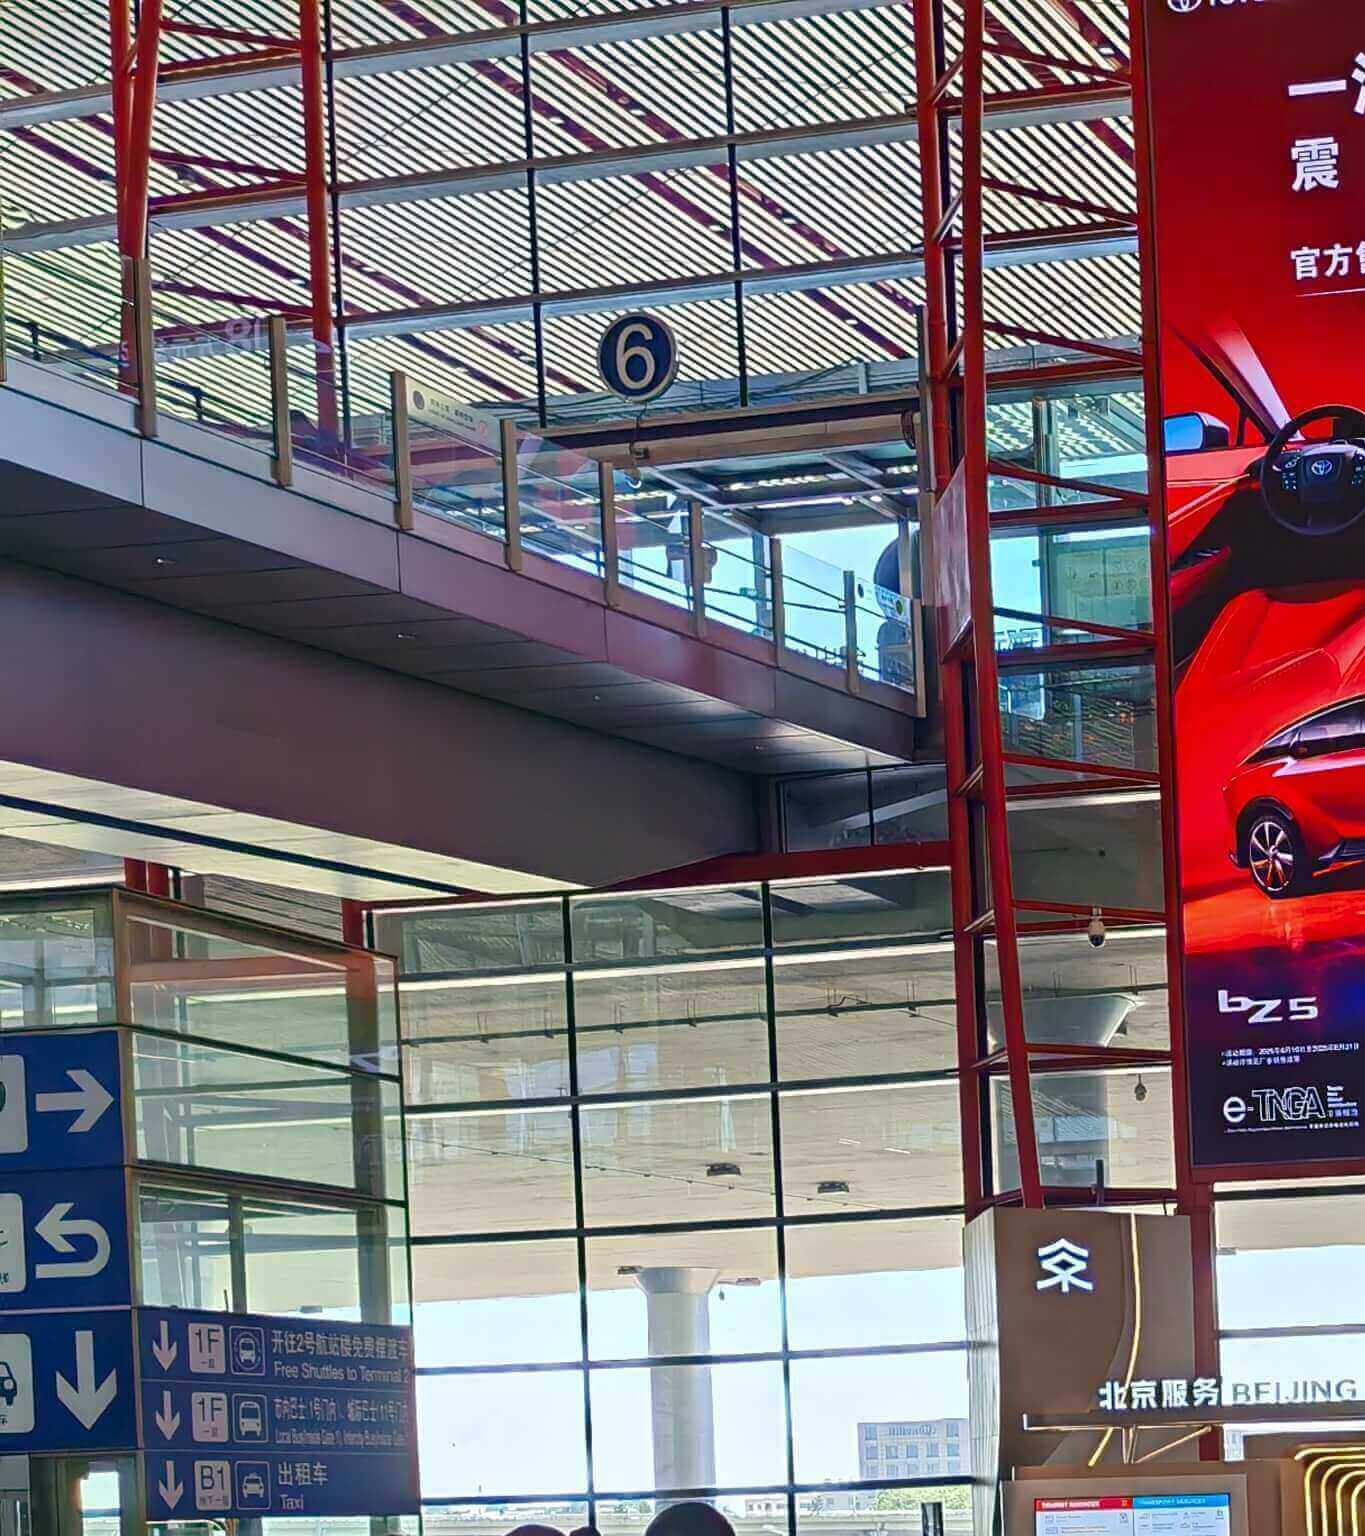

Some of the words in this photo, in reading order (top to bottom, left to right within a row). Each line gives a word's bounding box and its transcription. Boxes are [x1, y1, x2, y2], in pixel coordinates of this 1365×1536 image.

[616, 323, 657, 388] 6
[195, 1329, 220, 1354] 1F
[274, 1360, 299, 1380] Free
[303, 1363, 345, 1381] Shuttles
[347, 1365, 358, 1381] to
[361, 1366, 402, 1384] Terminal
[1098, 1376, 1222, 1411] 北京服务
[1231, 1377, 1358, 1405] BEIJING
[197, 1398, 224, 1423] 1F
[200, 1466, 226, 1491] B1
[278, 1461, 330, 1487] 出租车
[280, 1494, 305, 1511] Taxi
